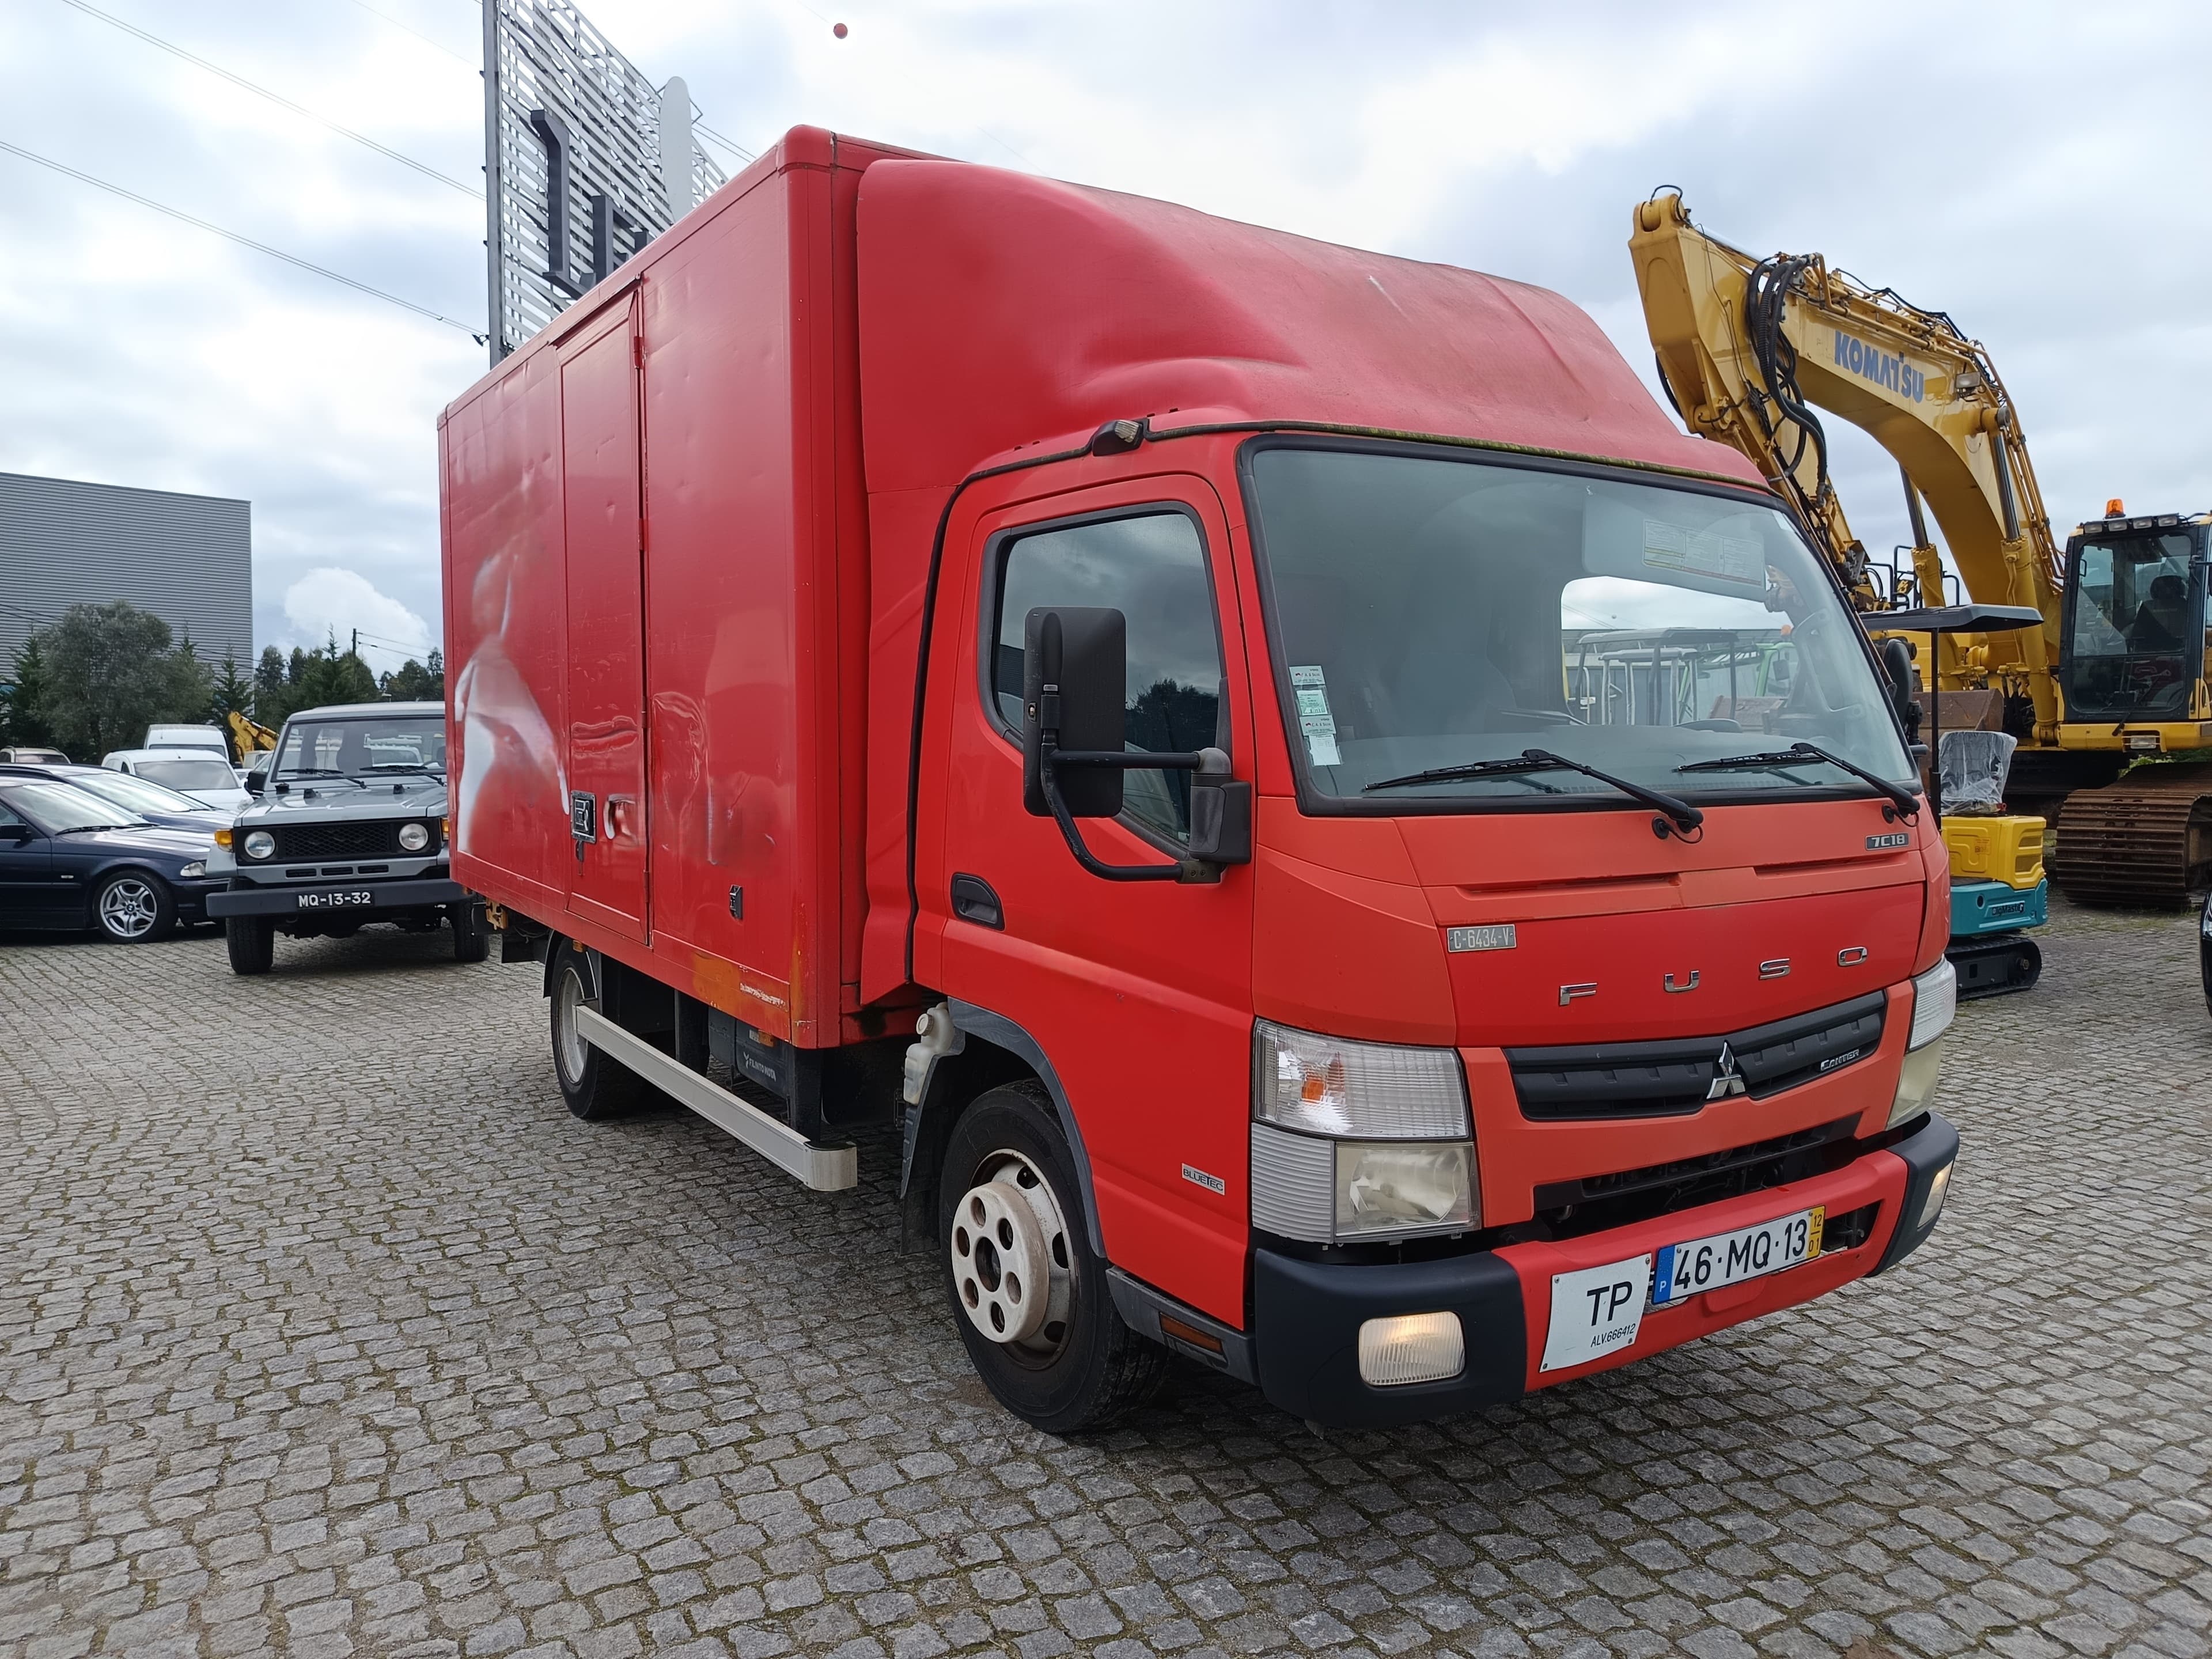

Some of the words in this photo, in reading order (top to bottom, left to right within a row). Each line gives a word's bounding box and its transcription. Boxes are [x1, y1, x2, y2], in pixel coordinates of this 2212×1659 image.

[1835, 329, 1924, 404] KOMATSU
[1872, 834, 1906, 847] 7C18
[298, 892, 371, 907] MQ-13-32
[1454, 927, 1509, 949] C-6434-V
[1559, 946, 1868, 1006] FUSO
[749, 1058, 764, 1073] FILINTO
[764, 1065, 777, 1082] MOTA
[1814, 1214, 1821, 1228] 12
[1659, 1280, 1666, 1293] P
[1808, 1238, 1820, 1252] 01
[1586, 1281, 1633, 1327] TP
[1590, 1323, 1636, 1348] ALV.666412
